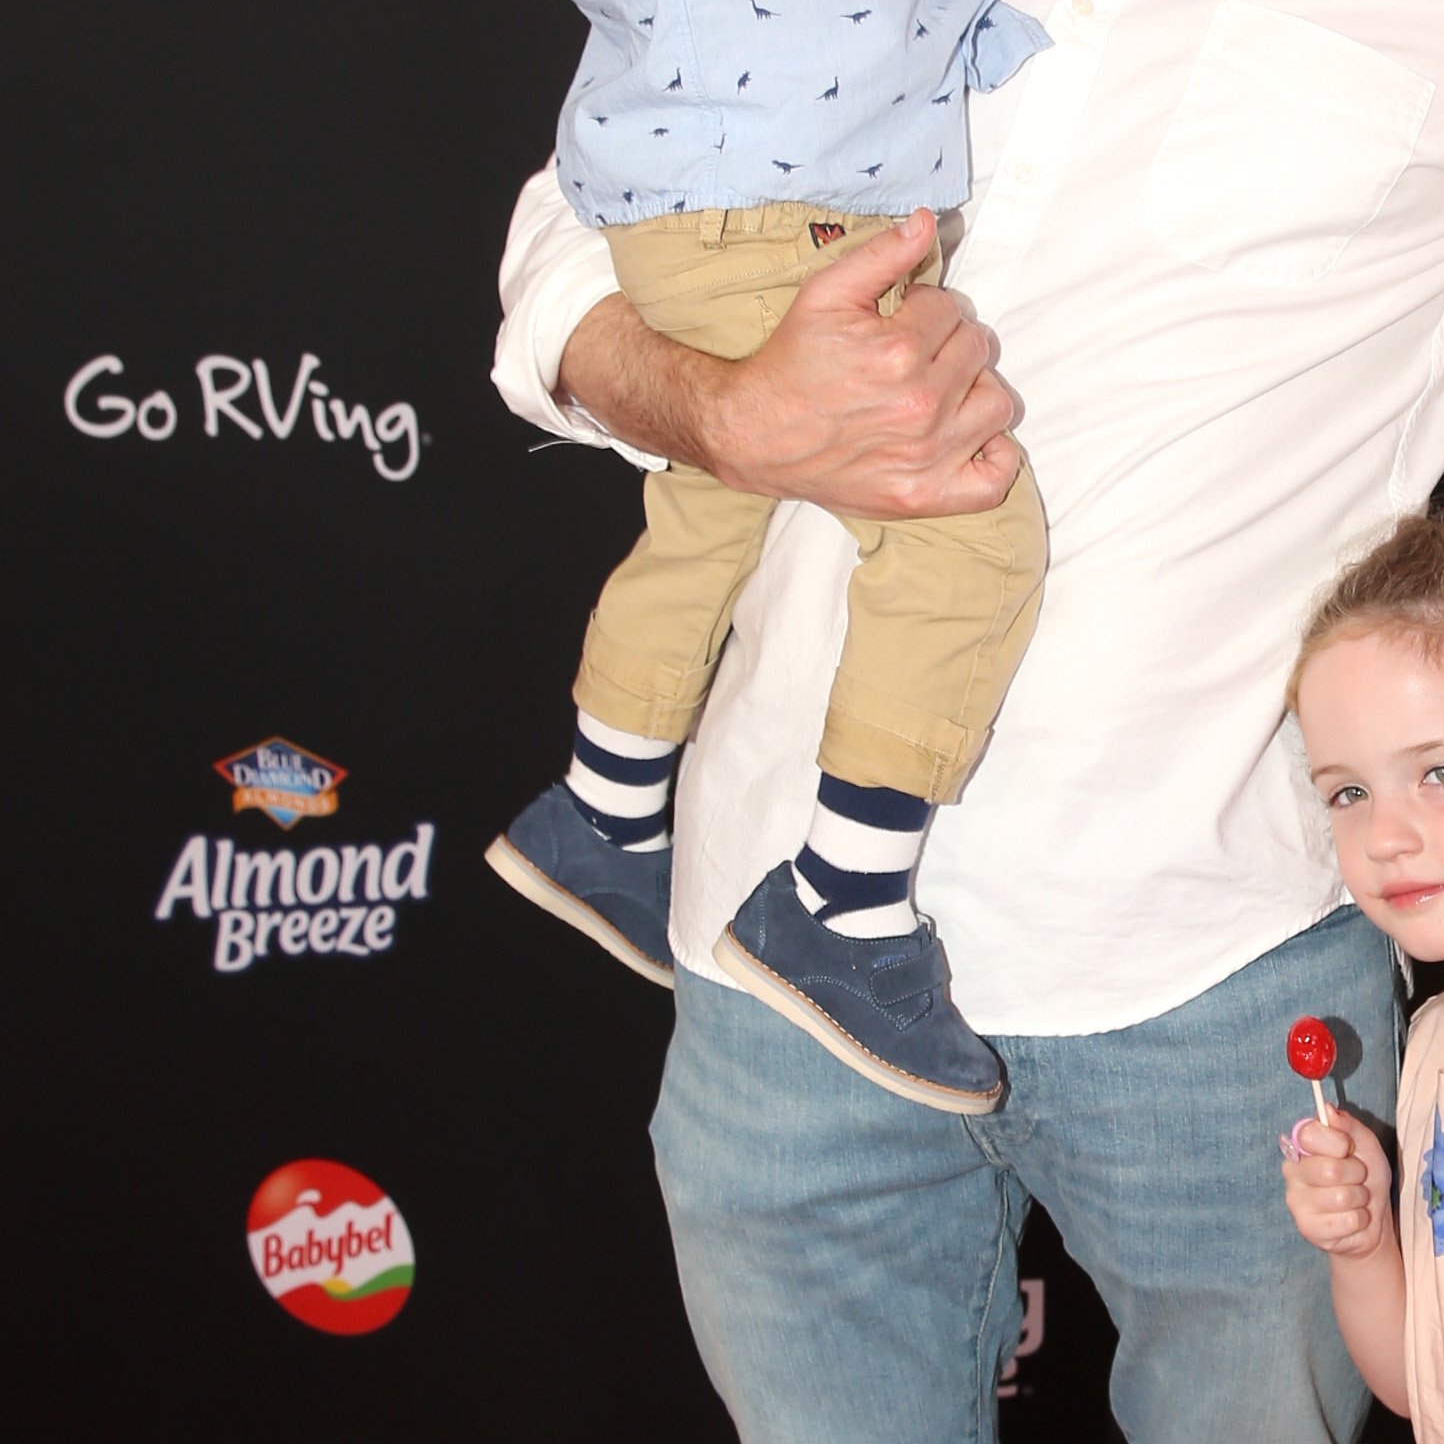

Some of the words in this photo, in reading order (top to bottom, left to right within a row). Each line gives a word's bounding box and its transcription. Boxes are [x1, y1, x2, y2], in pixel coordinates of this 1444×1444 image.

[64, 354, 178, 441] Go
[195, 353, 421, 482] RVing
[154, 822, 435, 920] Almond
[213, 905, 396, 973] Breeze
[263, 1214, 393, 1278] Babybel
